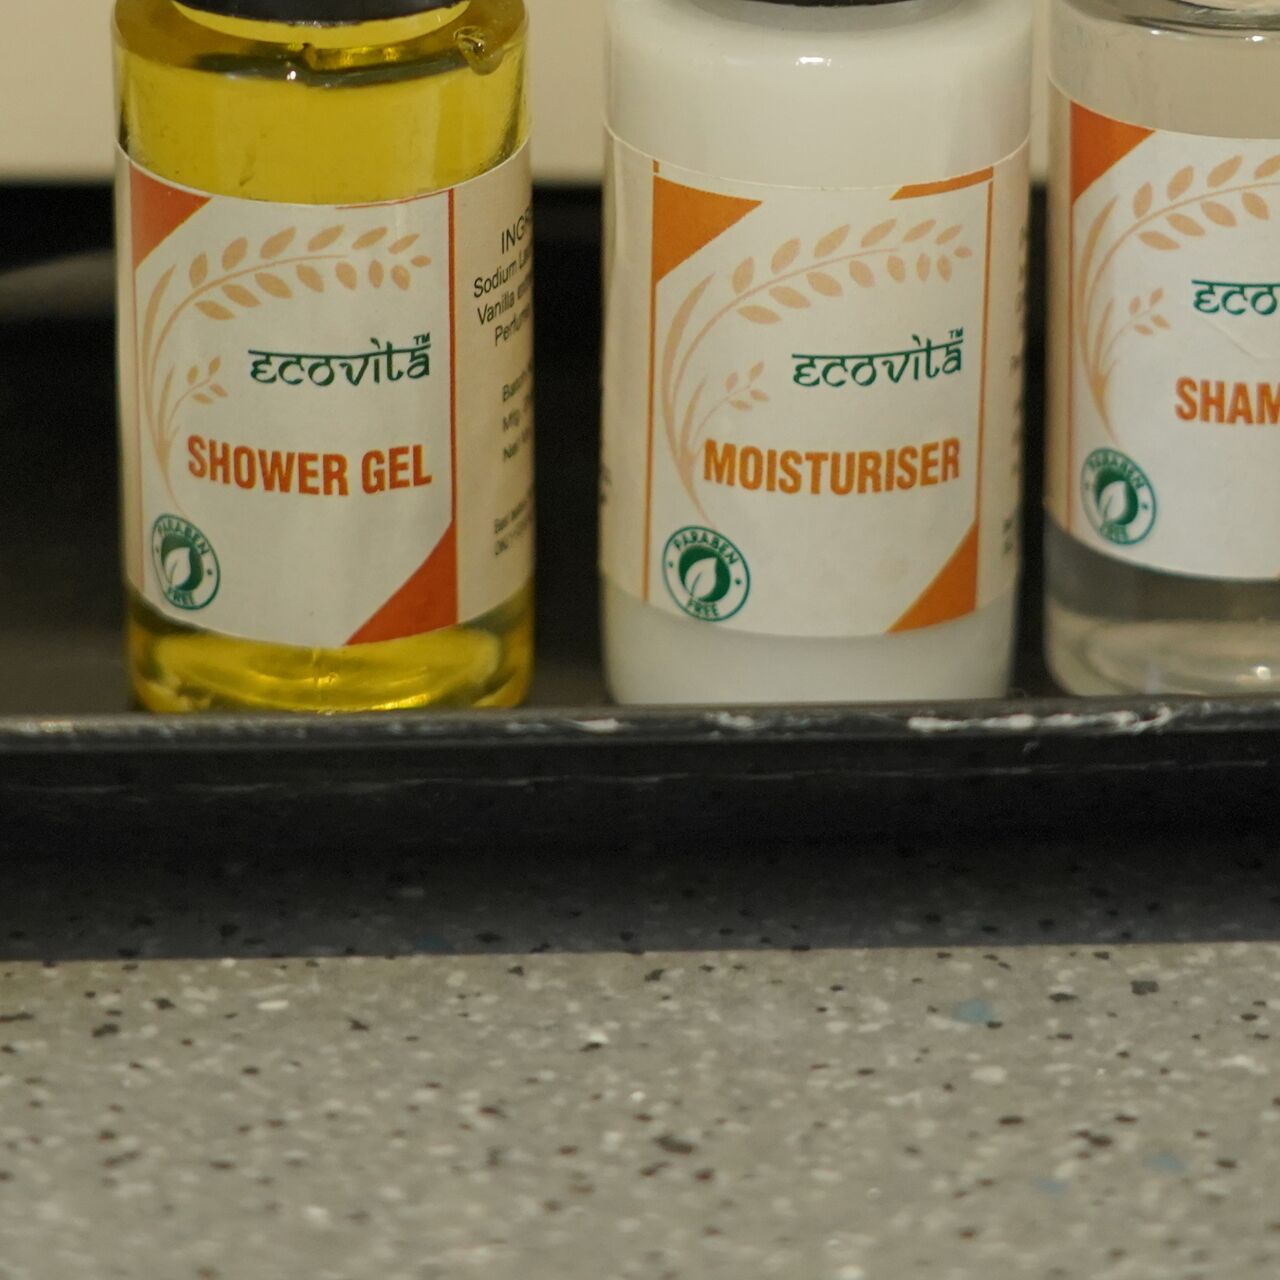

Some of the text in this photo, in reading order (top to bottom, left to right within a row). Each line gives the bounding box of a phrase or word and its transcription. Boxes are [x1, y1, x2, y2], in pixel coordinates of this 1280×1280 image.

[473, 261, 517, 298] Sodium
[477, 290, 515, 326] Vanilla
[187, 434, 433, 497] SHOWER GEL
[702, 437, 961, 496] MOISTURISER
[672, 530, 739, 566] PARABEN
[687, 597, 720, 617] FREE
